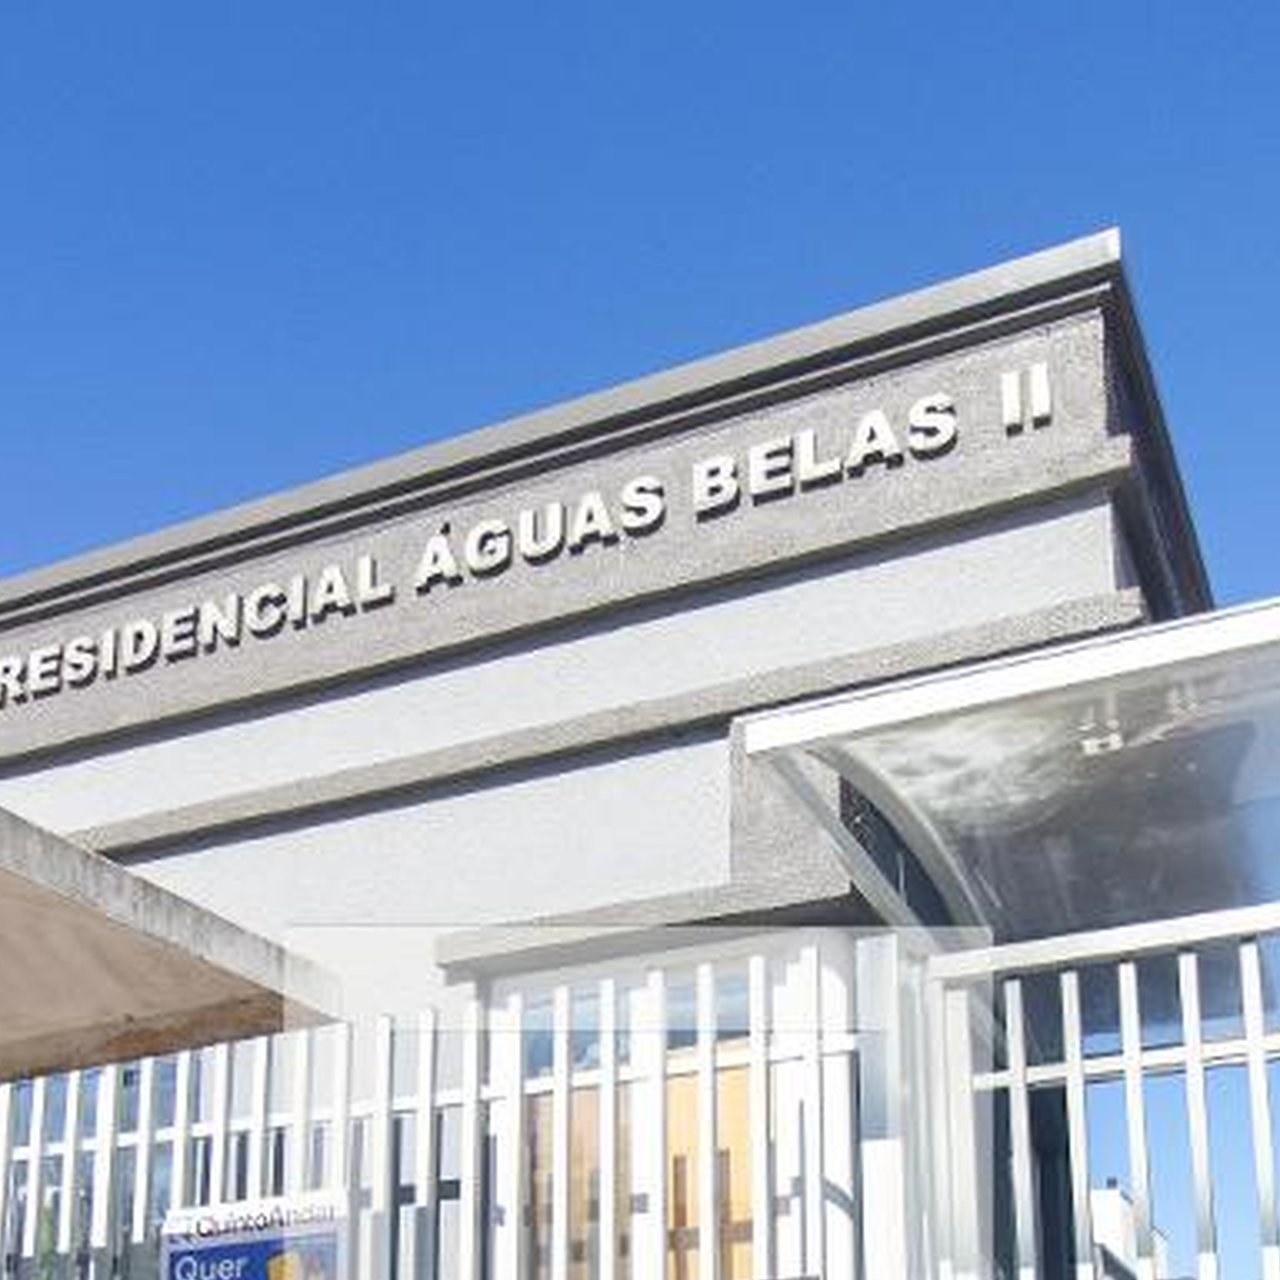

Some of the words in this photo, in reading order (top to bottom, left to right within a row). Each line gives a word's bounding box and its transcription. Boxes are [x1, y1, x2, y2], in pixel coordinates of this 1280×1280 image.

[414, 472, 666, 590] ÁGUAS
[692, 394, 960, 518] BELAS
[1000, 362, 1052, 434] II
